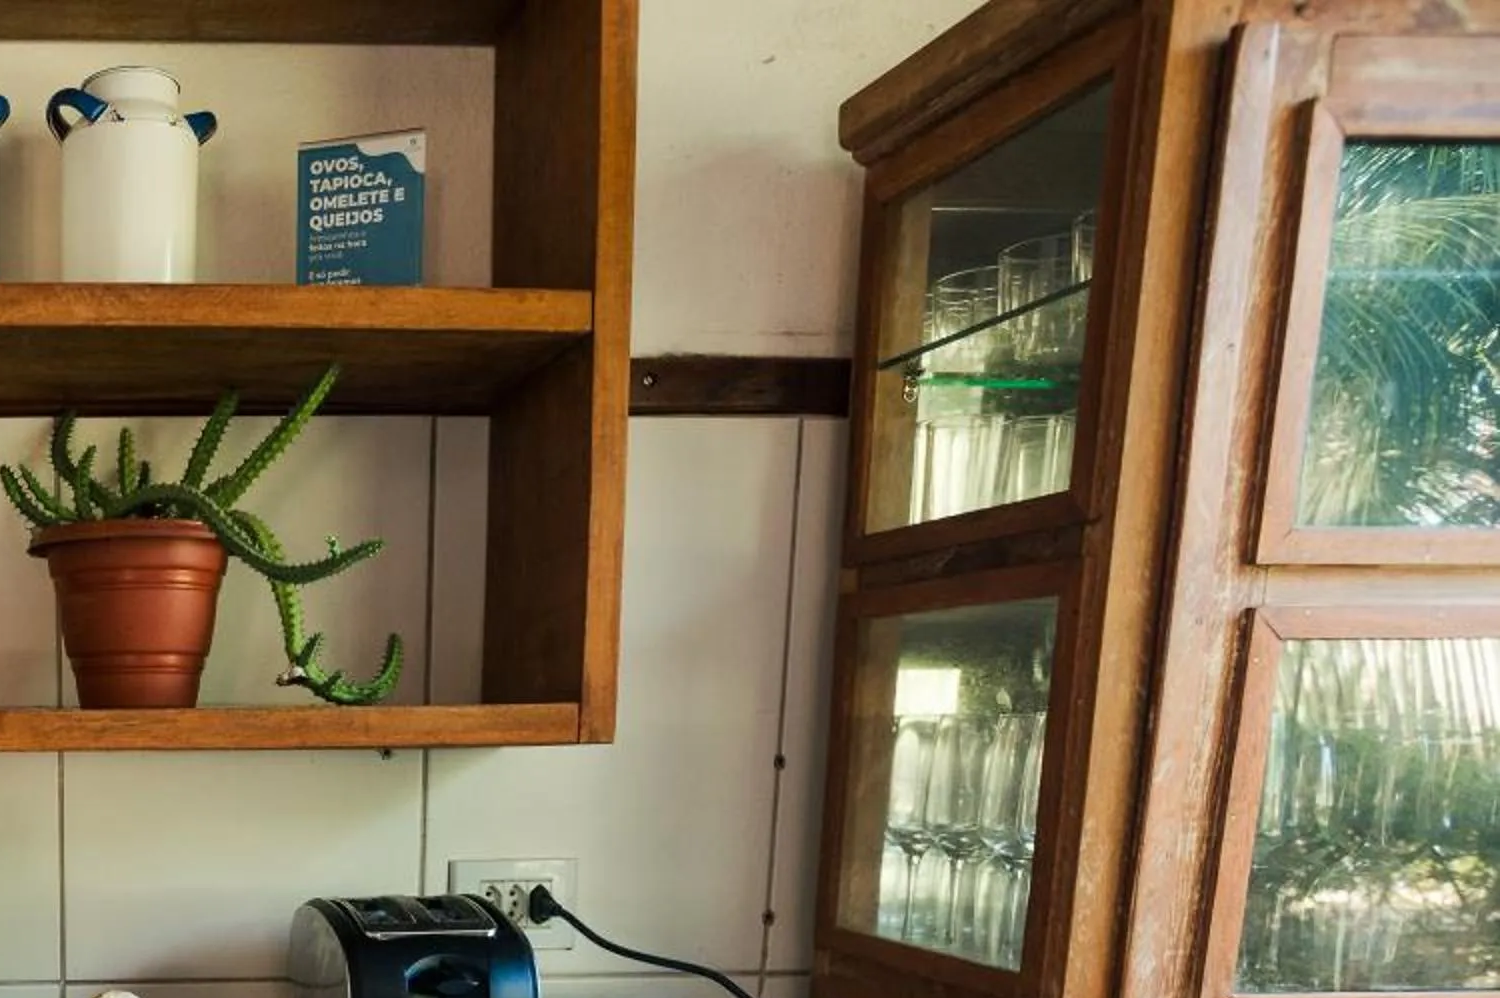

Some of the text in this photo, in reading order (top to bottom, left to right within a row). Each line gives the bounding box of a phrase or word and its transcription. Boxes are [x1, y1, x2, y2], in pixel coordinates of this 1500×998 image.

[309, 157, 364, 175] OVOS,
[309, 172, 392, 193] TAPIOCA,
[309, 187, 405, 211] OMELETE E
[309, 208, 384, 231] QUEIJOS
